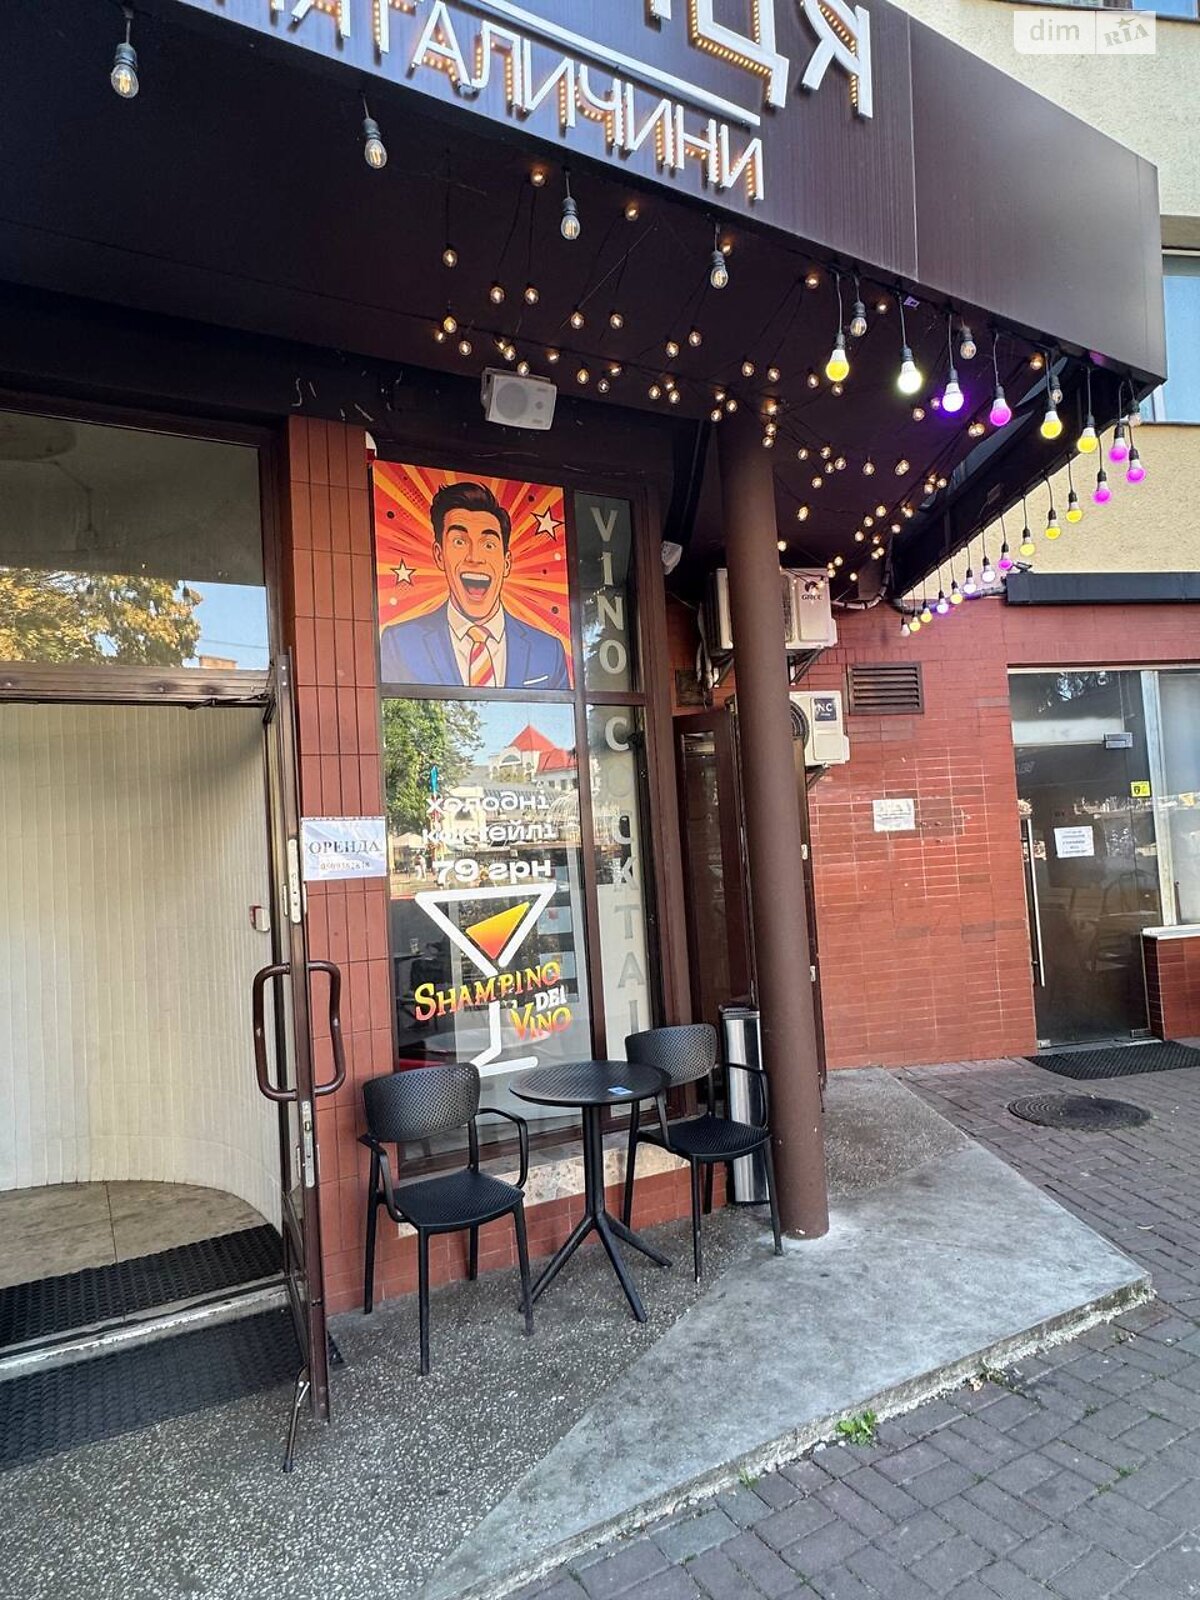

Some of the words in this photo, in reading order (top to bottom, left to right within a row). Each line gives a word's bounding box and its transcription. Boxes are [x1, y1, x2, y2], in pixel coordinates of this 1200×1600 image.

[590, 507, 627, 675] VINO
[309, 841, 382, 854] ОРЕНДА
[433, 858, 479, 889] 79
[488, 860, 551, 884] грн
[604, 716, 645, 1034] COCKTAI
[414, 961, 561, 1021] SHAMPINO
[510, 1002, 572, 1041] VINO
